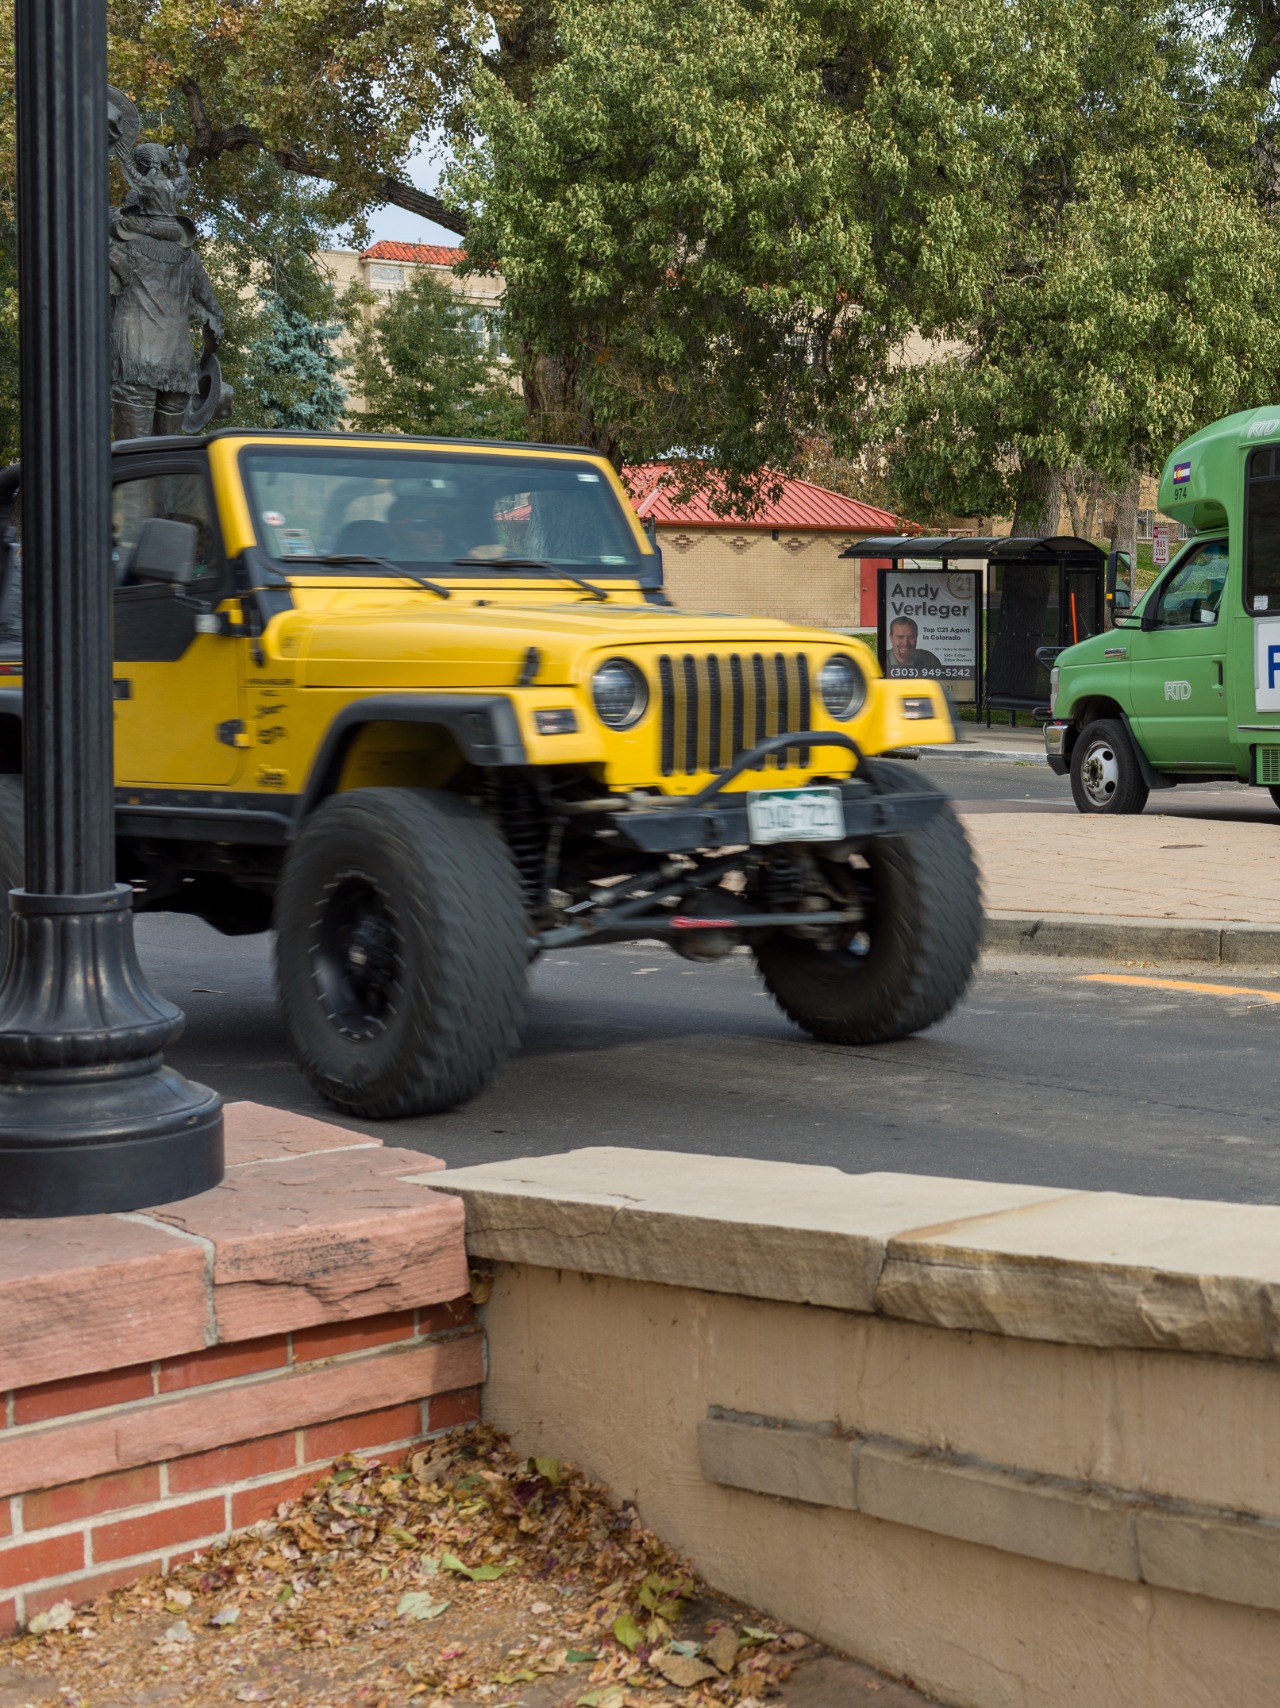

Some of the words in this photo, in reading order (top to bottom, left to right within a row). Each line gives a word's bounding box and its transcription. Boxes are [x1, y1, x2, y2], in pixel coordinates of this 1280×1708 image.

[1247, 419, 1280, 438] RTD
[1174, 487, 1188, 500] 974
[891, 583, 940, 601] Andy
[891, 601, 969, 619] Verleger
[891, 669, 919, 678] (303)
[922, 668, 971, 678] 949-5242
[1164, 680, 1191, 701] RTD
